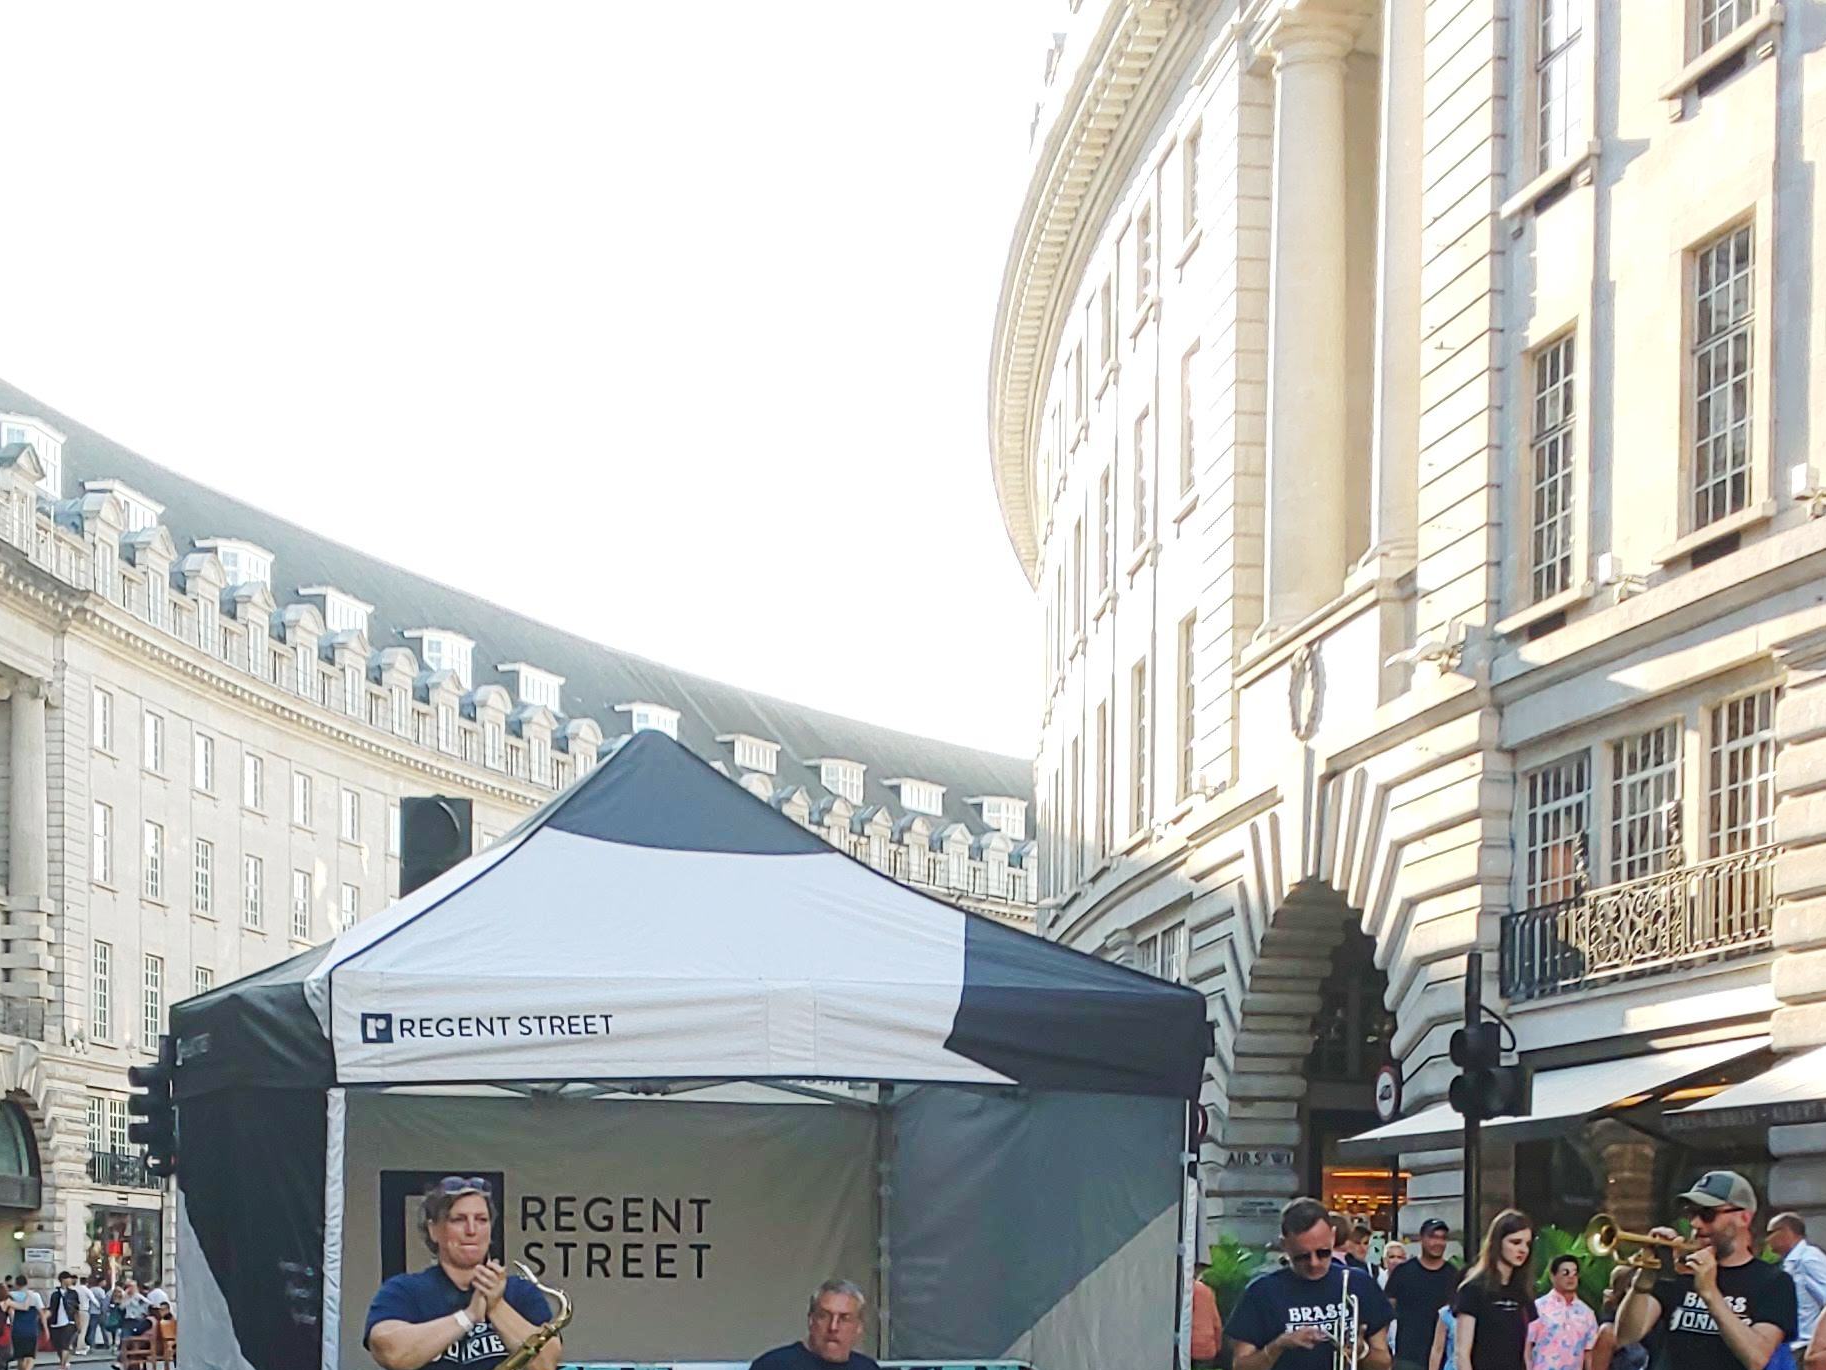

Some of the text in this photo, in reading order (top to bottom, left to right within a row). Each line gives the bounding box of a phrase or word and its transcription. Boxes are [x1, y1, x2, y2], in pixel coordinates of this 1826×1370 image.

[400, 1014, 613, 1038] REGENT STREET
[521, 1196, 711, 1234] REGENT
[523, 1243, 711, 1279] STREET
[1288, 1303, 1350, 1322] BRASS
